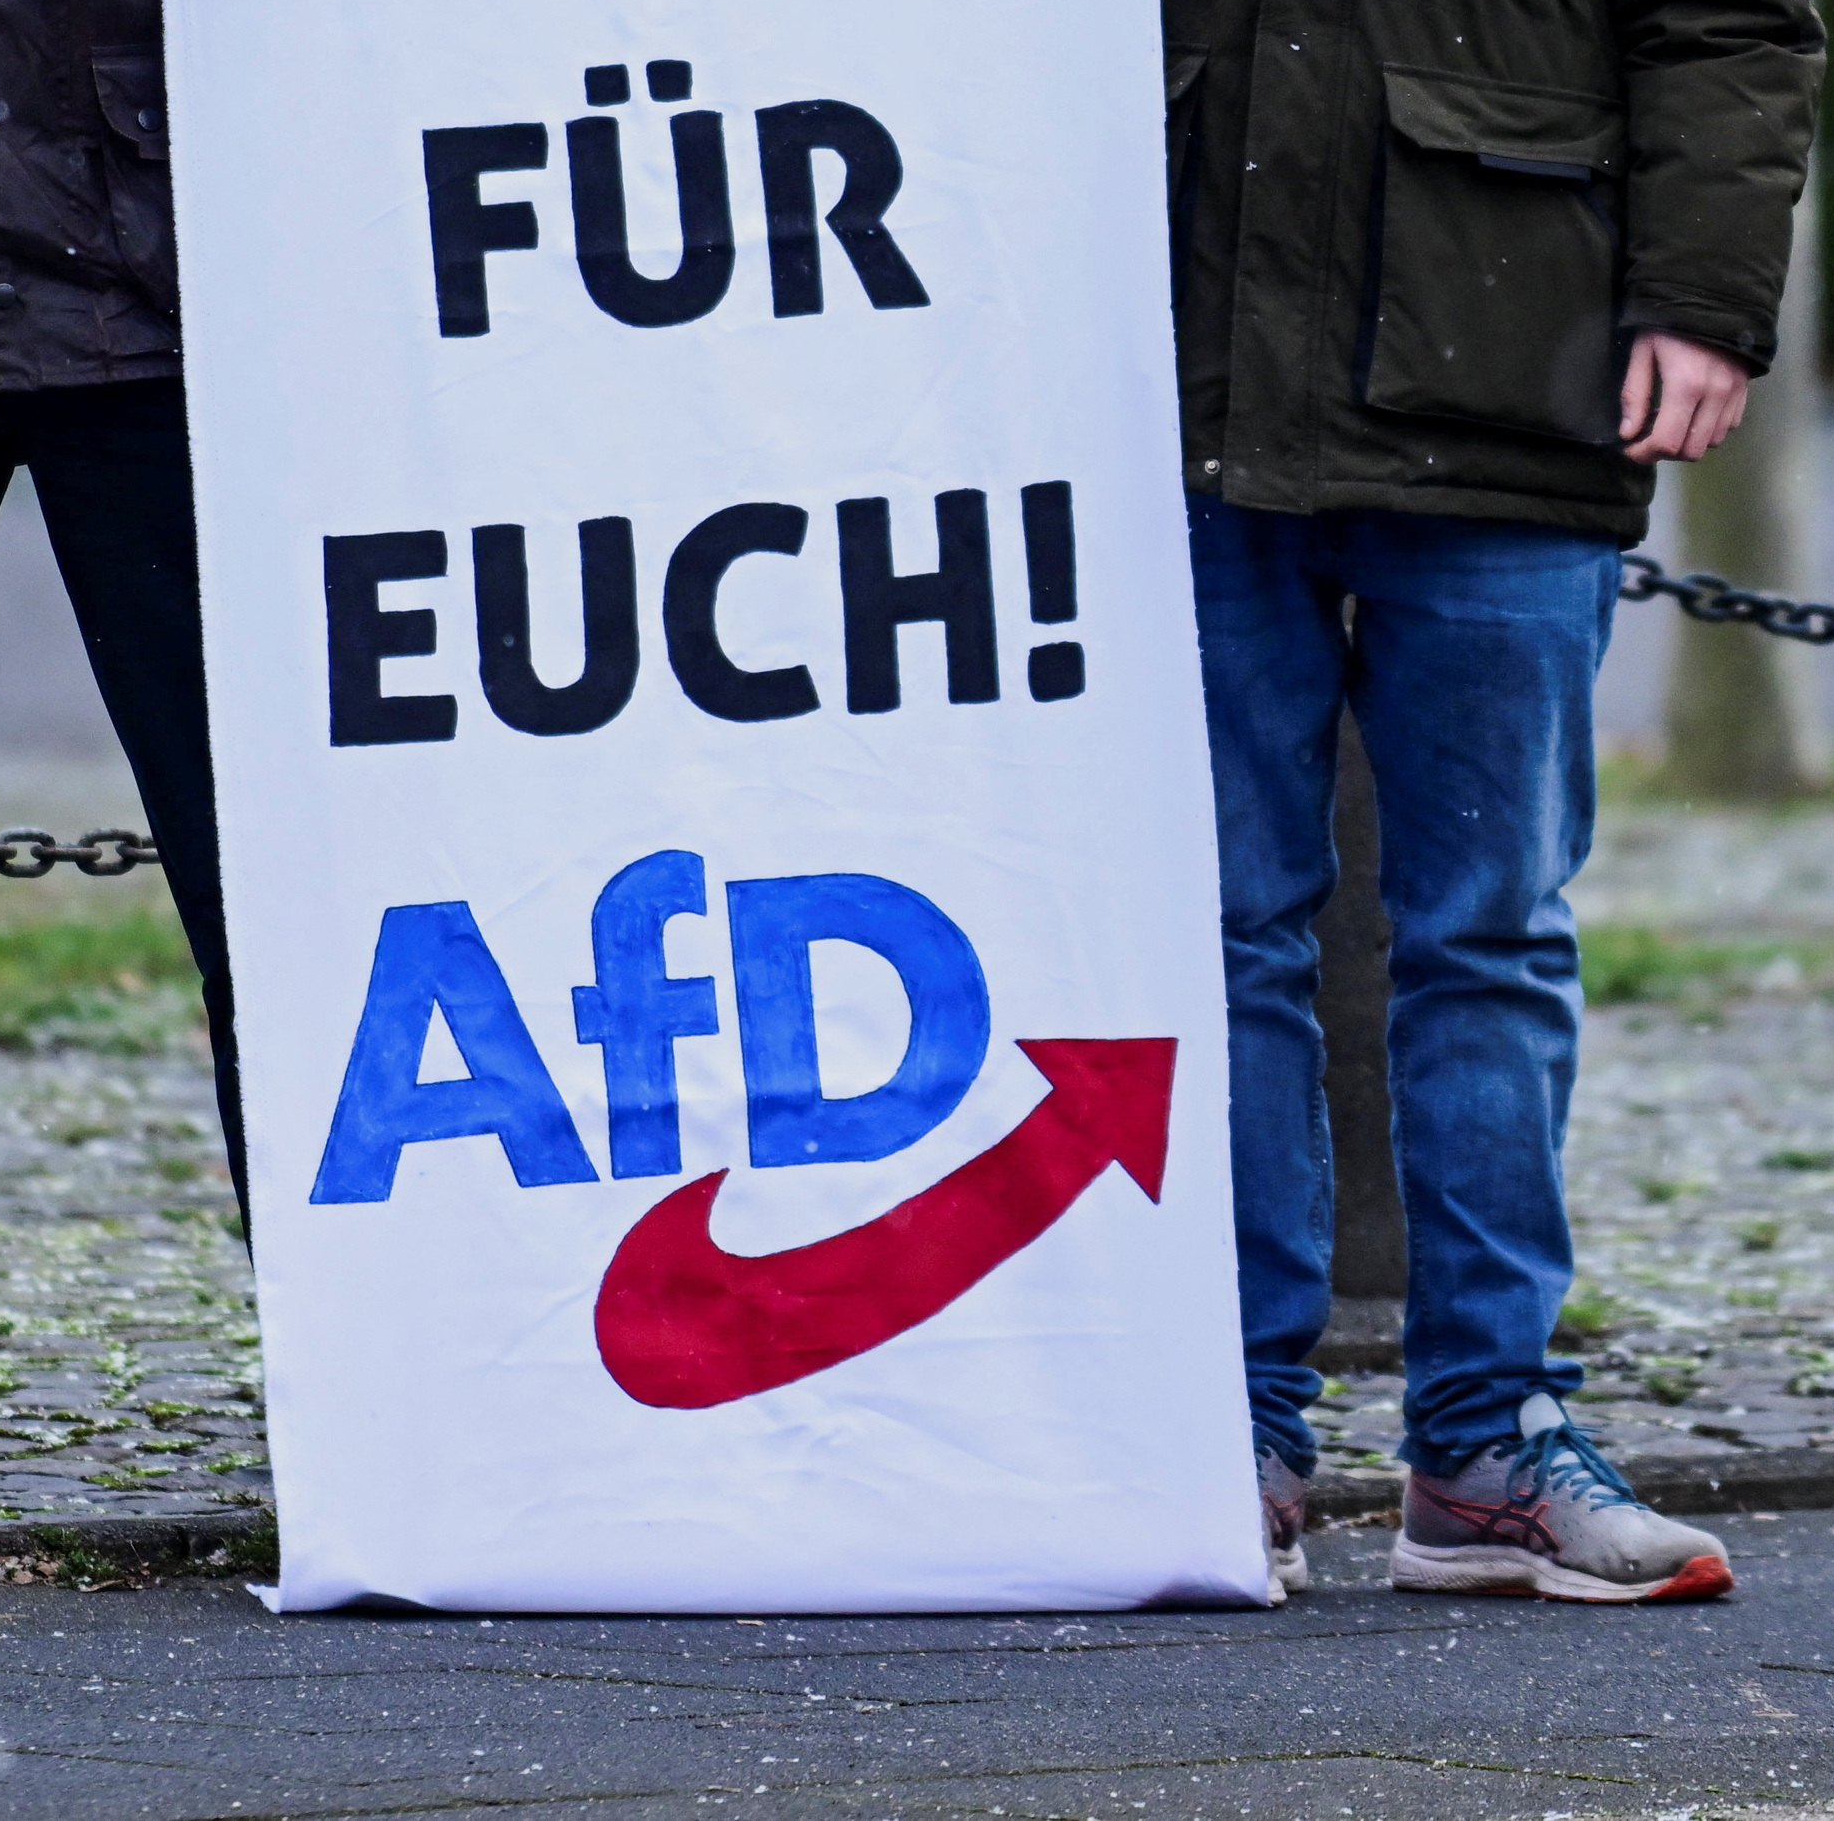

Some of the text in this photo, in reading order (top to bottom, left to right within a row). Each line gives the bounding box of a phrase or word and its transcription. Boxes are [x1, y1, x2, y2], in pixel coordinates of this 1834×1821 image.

[422, 58, 930, 338] FÜR
[323, 479, 1087, 747] EUCH!
[309, 849, 991, 1204] AfD
